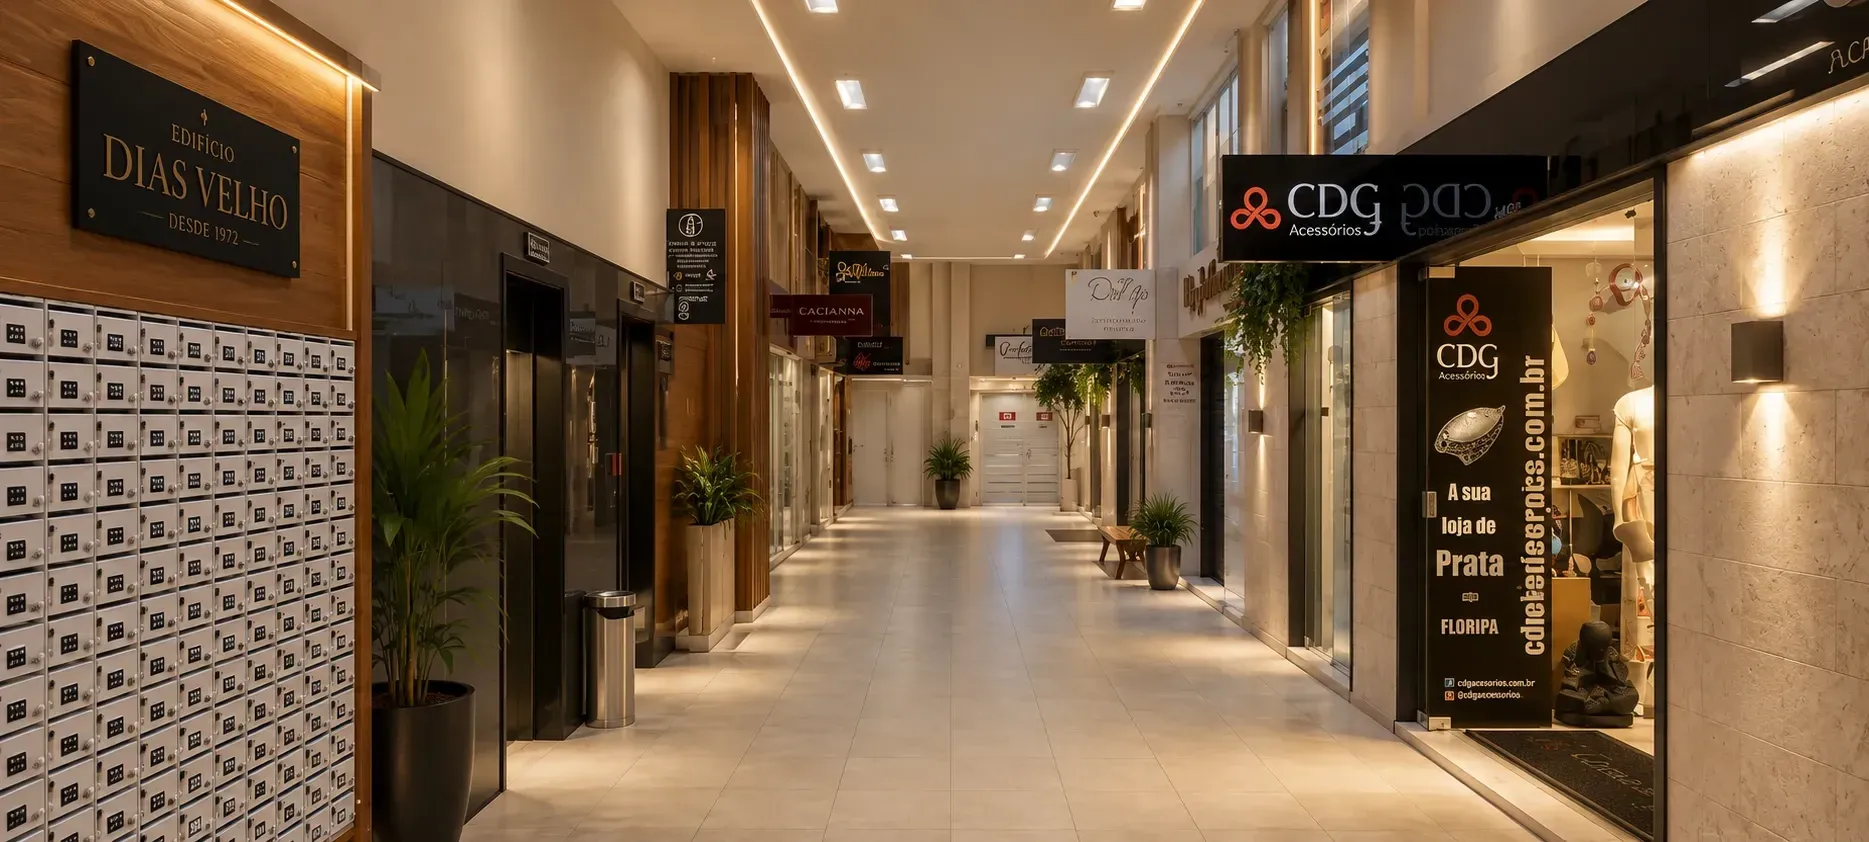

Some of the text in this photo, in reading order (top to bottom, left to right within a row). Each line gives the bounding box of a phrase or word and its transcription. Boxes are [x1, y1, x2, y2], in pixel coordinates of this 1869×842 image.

[171, 123, 235, 163] EDIFÍCIO
[103, 133, 289, 230] DIAS VELHO
[1287, 183, 1383, 236] CDG
[168, 212, 239, 246] DESDE 1972
[1289, 223, 1362, 237] Acessórios
[1436, 343, 1499, 380] CDG
[1448, 483, 1491, 501] A sua
[1441, 516, 1497, 537] loja de
[1436, 550, 1504, 577] Prata
[1441, 618, 1499, 635] FLORIPA
